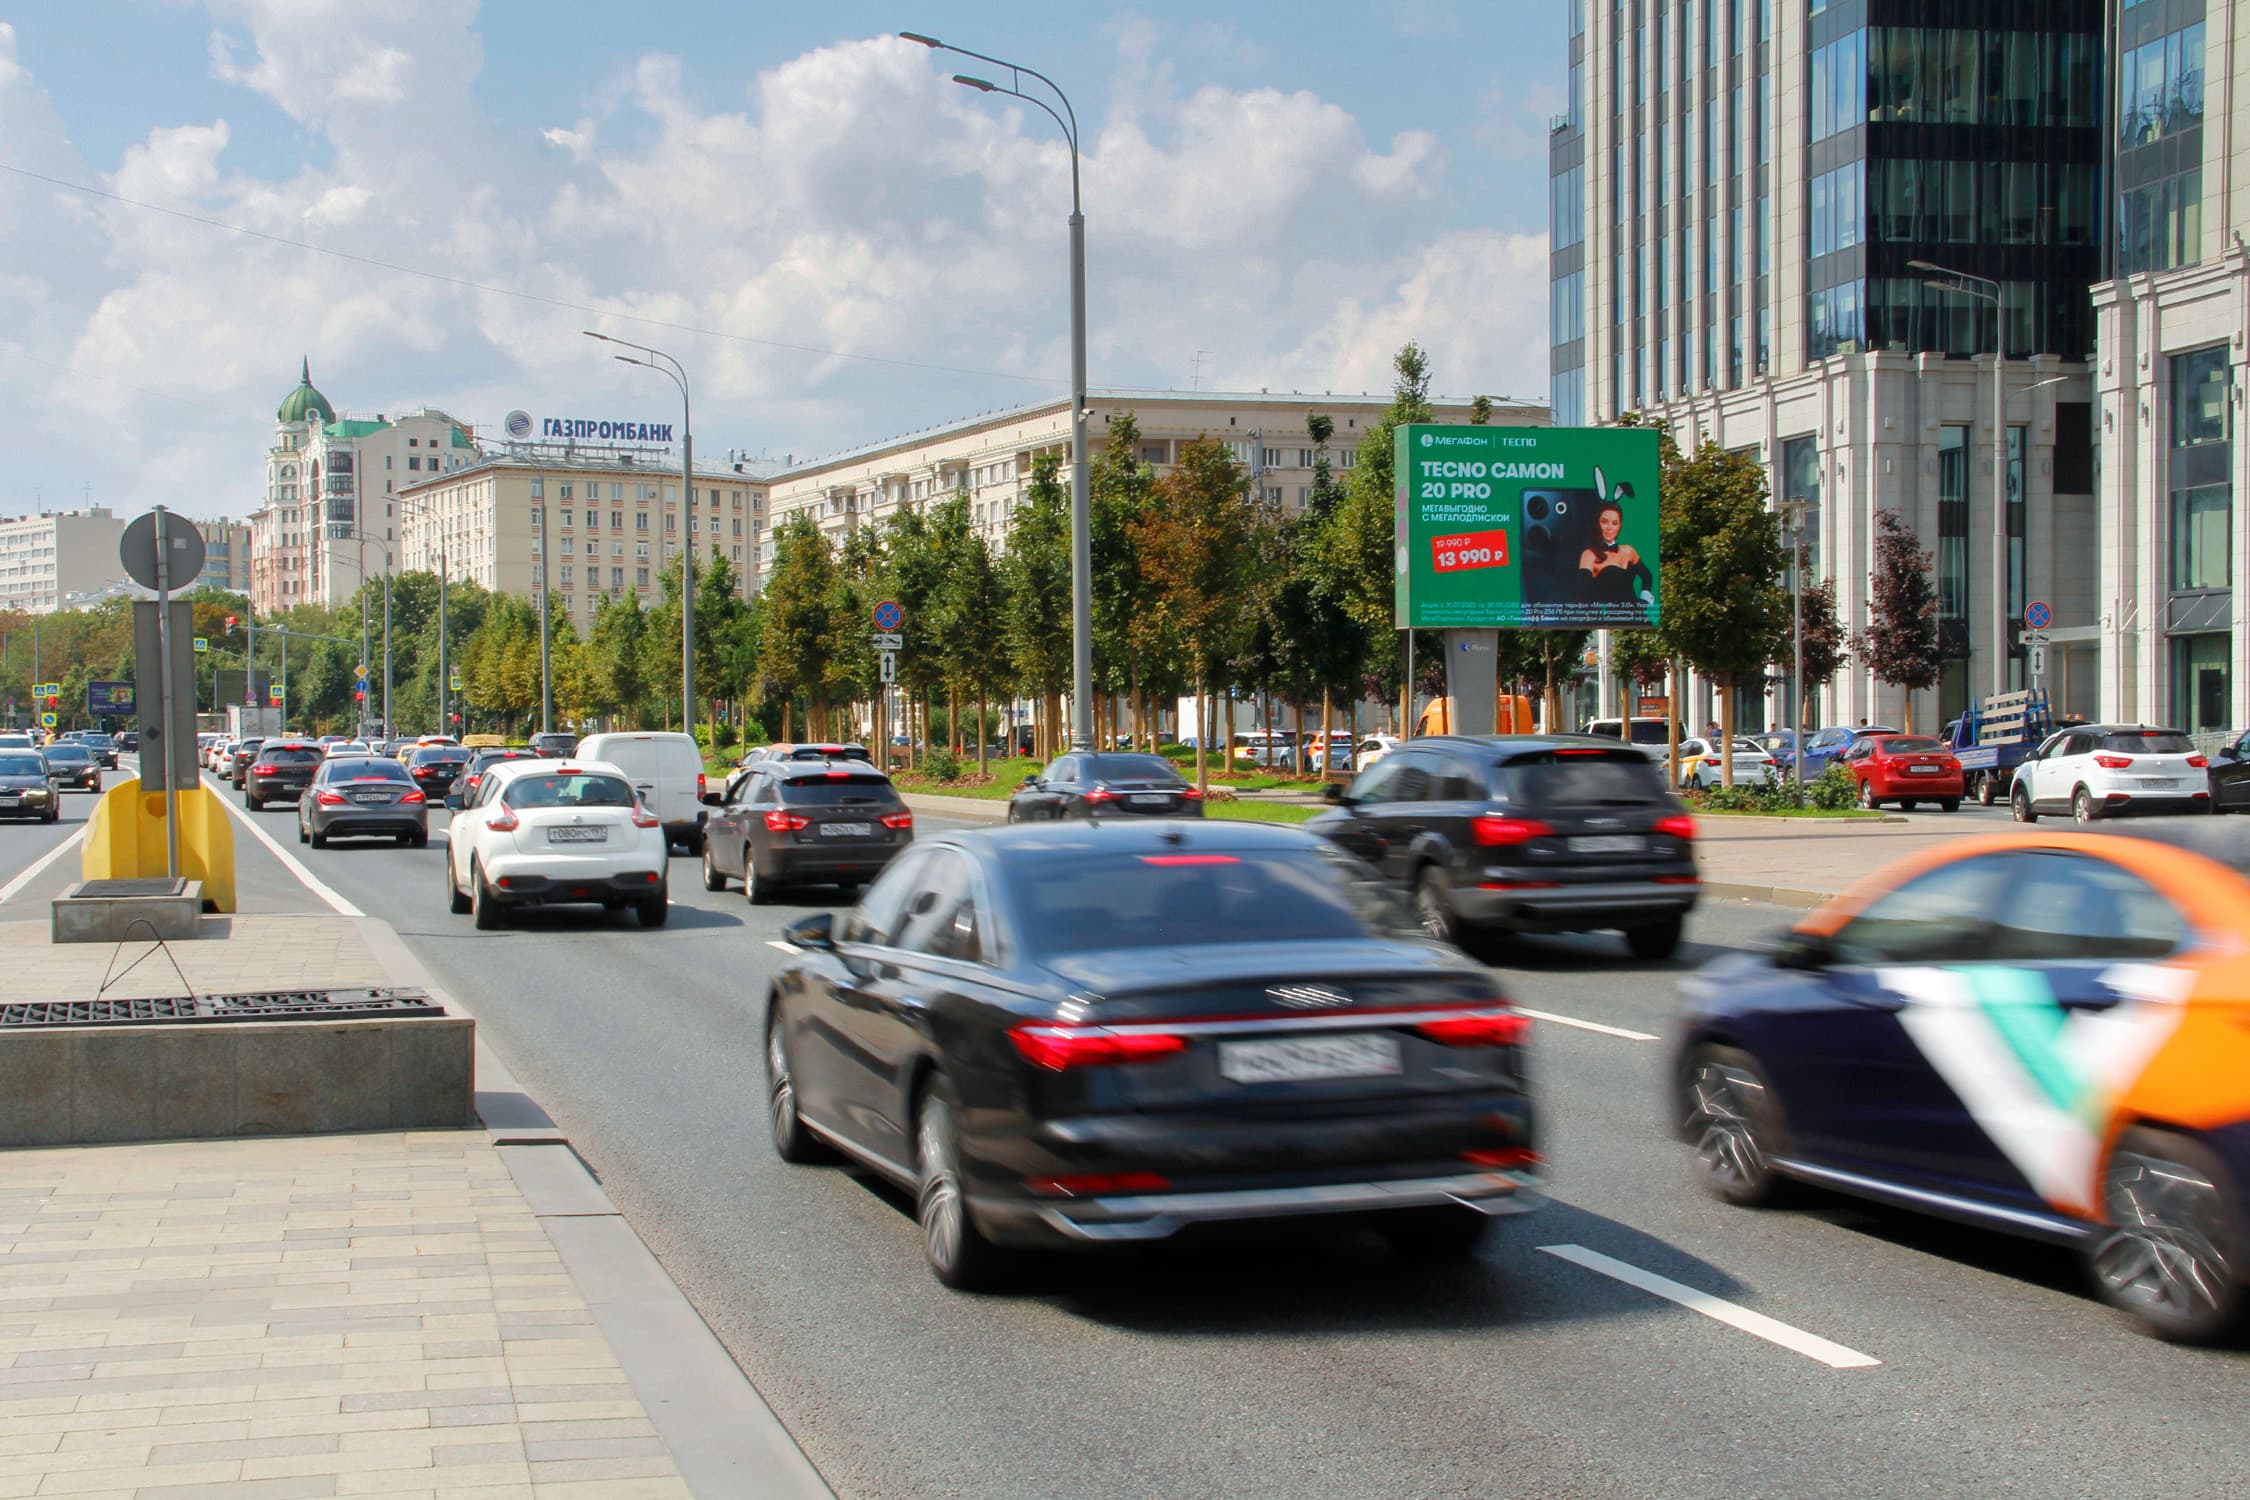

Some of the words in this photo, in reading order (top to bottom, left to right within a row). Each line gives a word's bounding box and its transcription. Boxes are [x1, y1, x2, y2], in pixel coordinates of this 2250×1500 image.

[543, 418, 673, 442] ГАЗПРОМБАНК
[1420, 461, 1487, 479] TECNO
[1491, 463, 1565, 479] CAMON
[1421, 483, 1445, 499] 20
[1451, 483, 1491, 499] PRO
[1422, 504, 1488, 514] МЕГАВЫГОДНО
[1422, 514, 1429, 522] С
[1438, 551, 1456, 567] 13
[1459, 548, 1491, 565] 990
